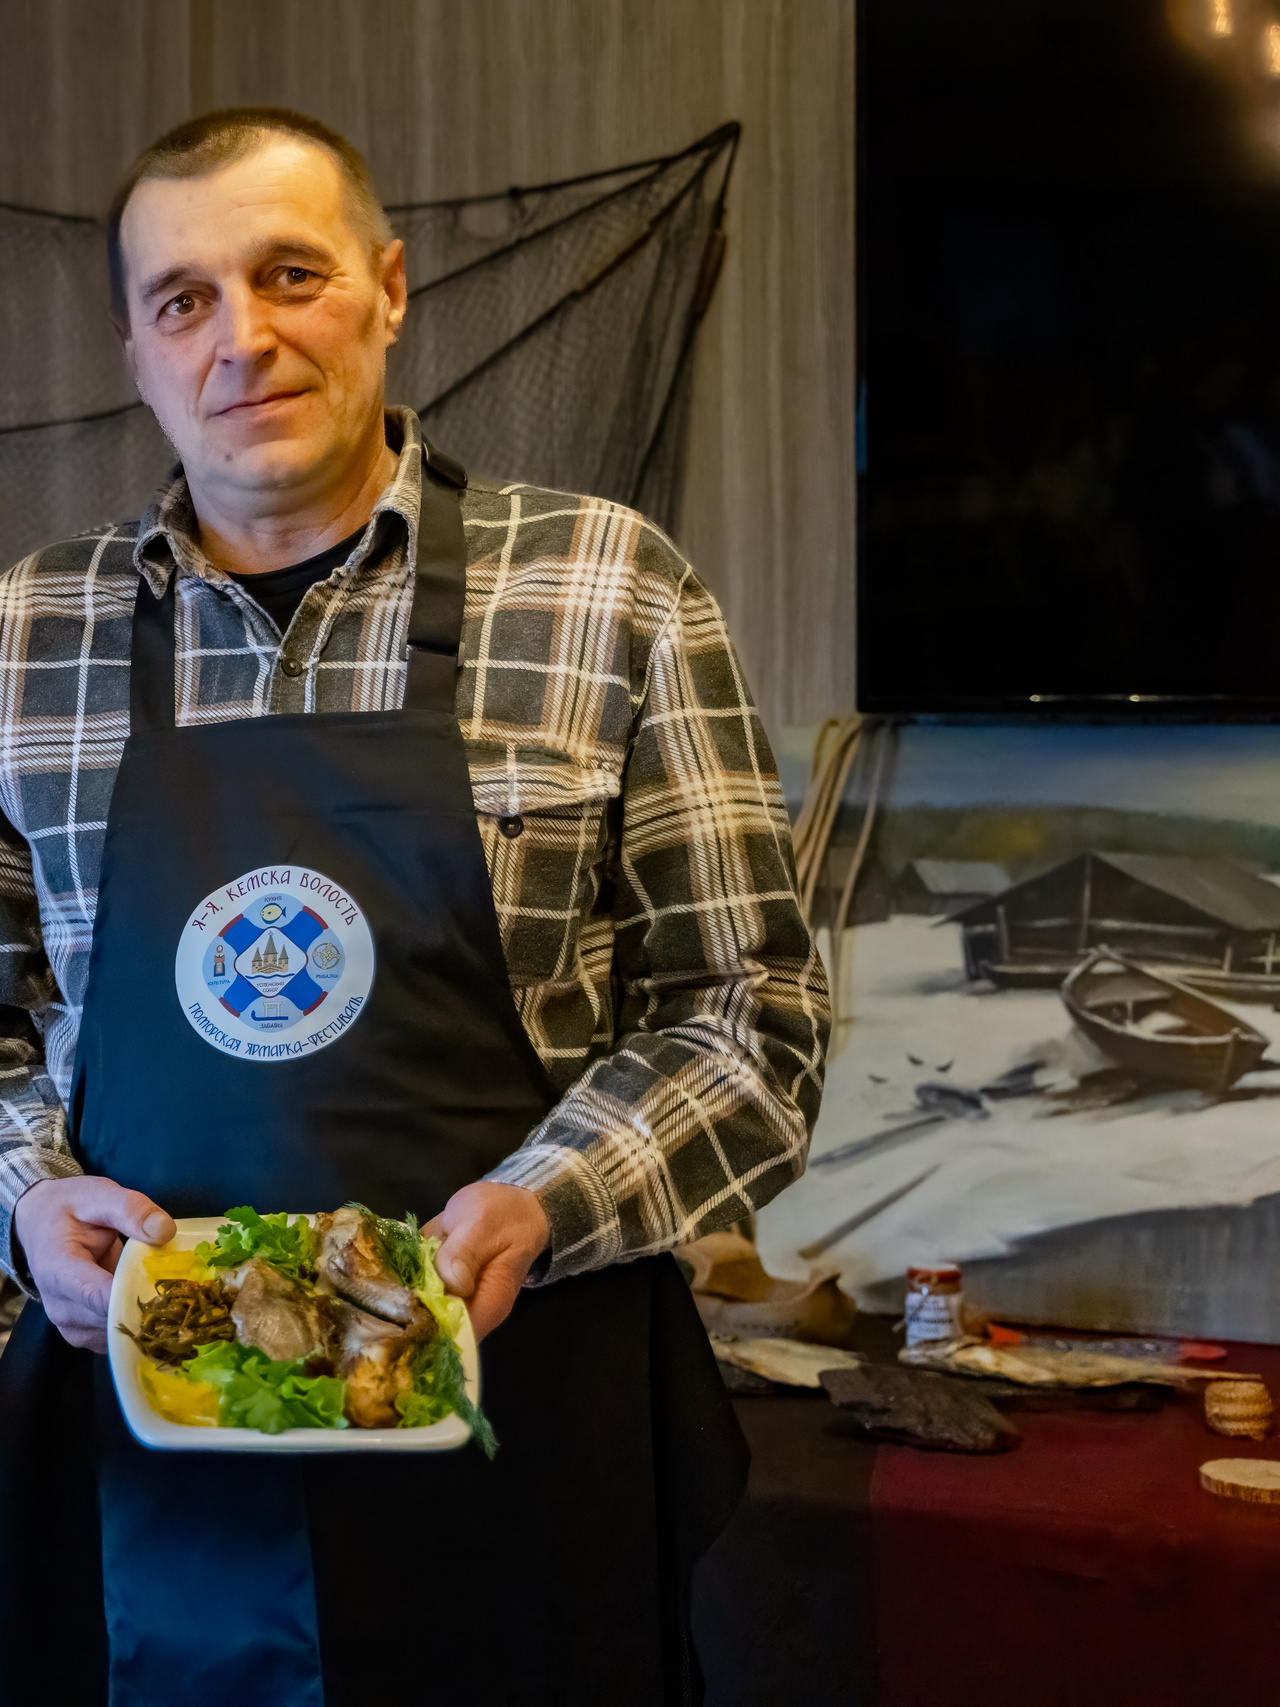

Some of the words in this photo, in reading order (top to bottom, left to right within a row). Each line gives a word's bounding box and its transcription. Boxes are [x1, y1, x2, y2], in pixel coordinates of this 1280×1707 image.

[226, 869, 291, 902] КЕМСКА
[299, 872, 360, 926] ВОЛОСТЬ
[188, 1002, 241, 1052] ПОМОРСКАЯ
